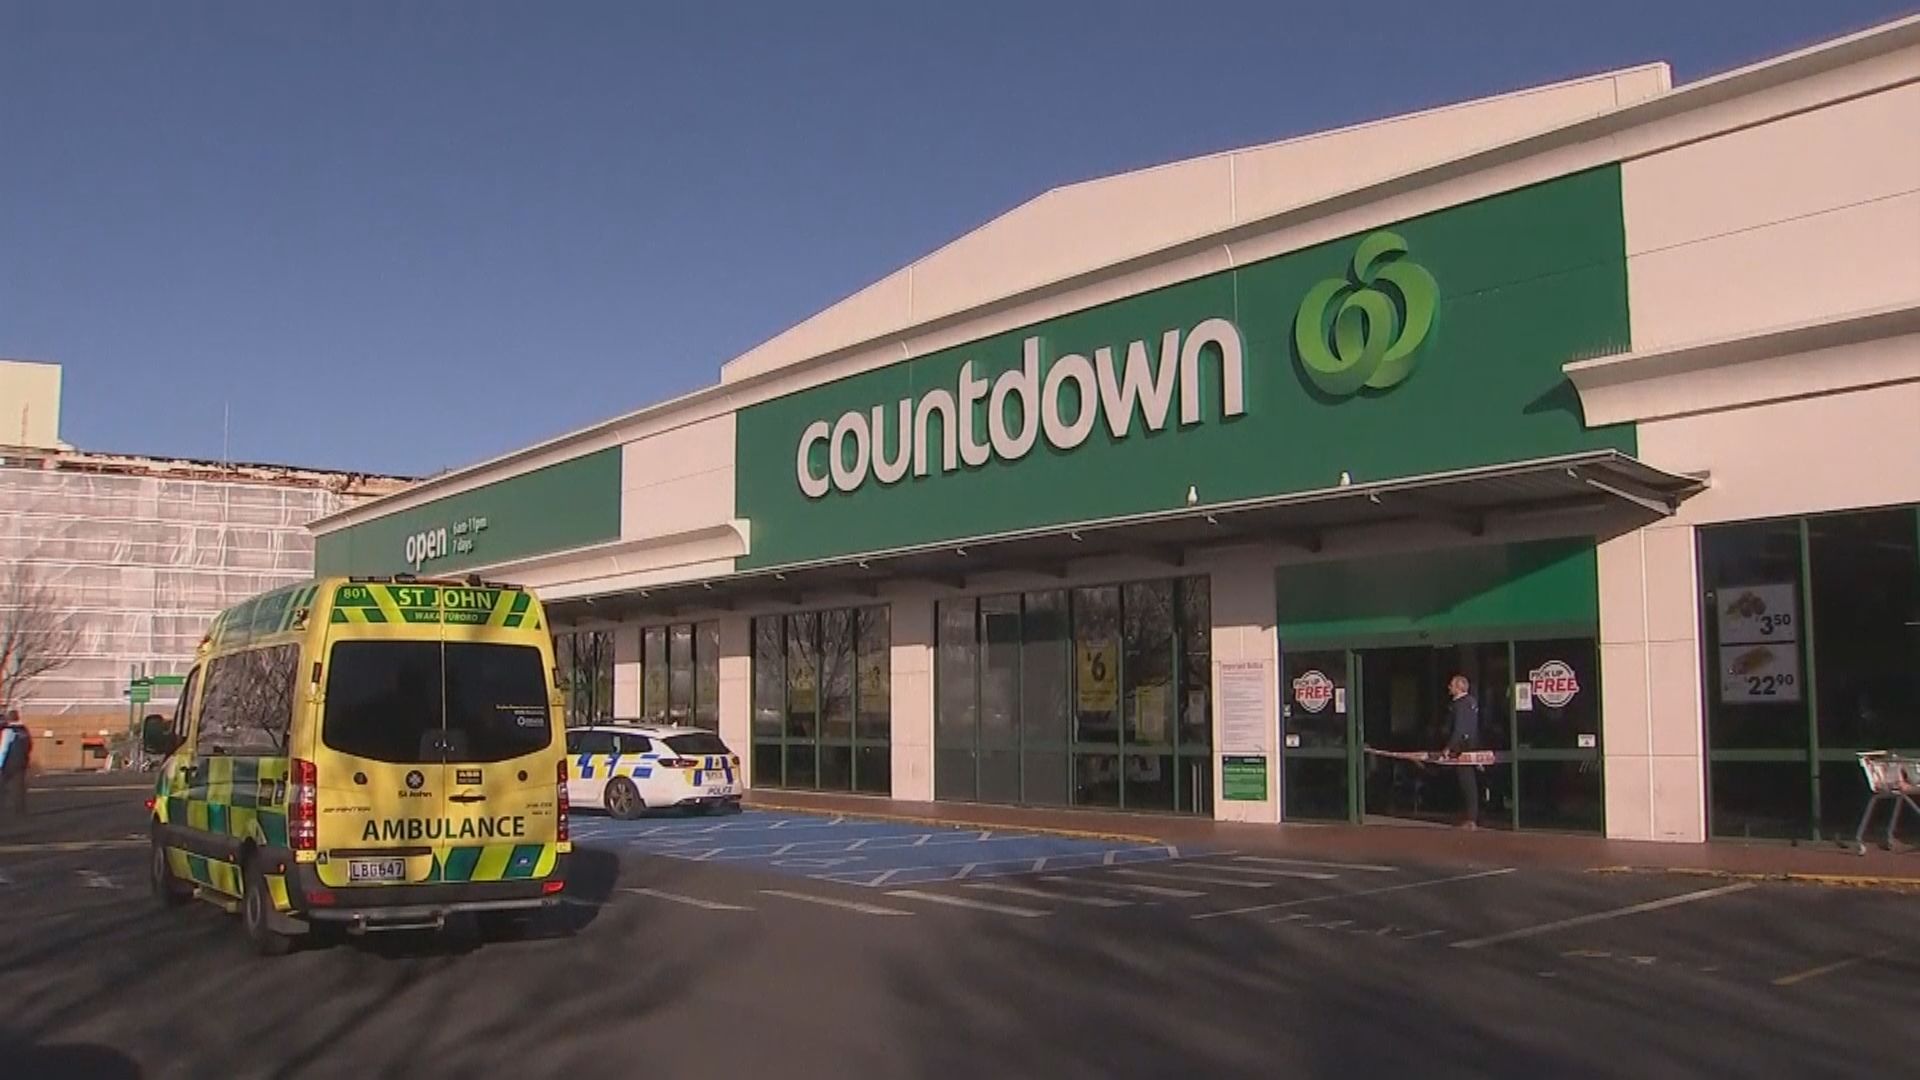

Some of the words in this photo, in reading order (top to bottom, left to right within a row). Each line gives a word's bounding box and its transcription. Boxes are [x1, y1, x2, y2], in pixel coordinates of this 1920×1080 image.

[797, 318, 1244, 498] countdown
[406, 527, 447, 571] open
[453, 539, 458, 553] 7
[458, 537, 472, 553] days
[343, 588, 367, 599] 801
[399, 588, 425, 606] ST
[431, 590, 492, 609] JOHN
[1297, 686, 1330, 699] FREE
[1534, 678, 1577, 693] FREE
[362, 816, 526, 841] AMBULANCE
